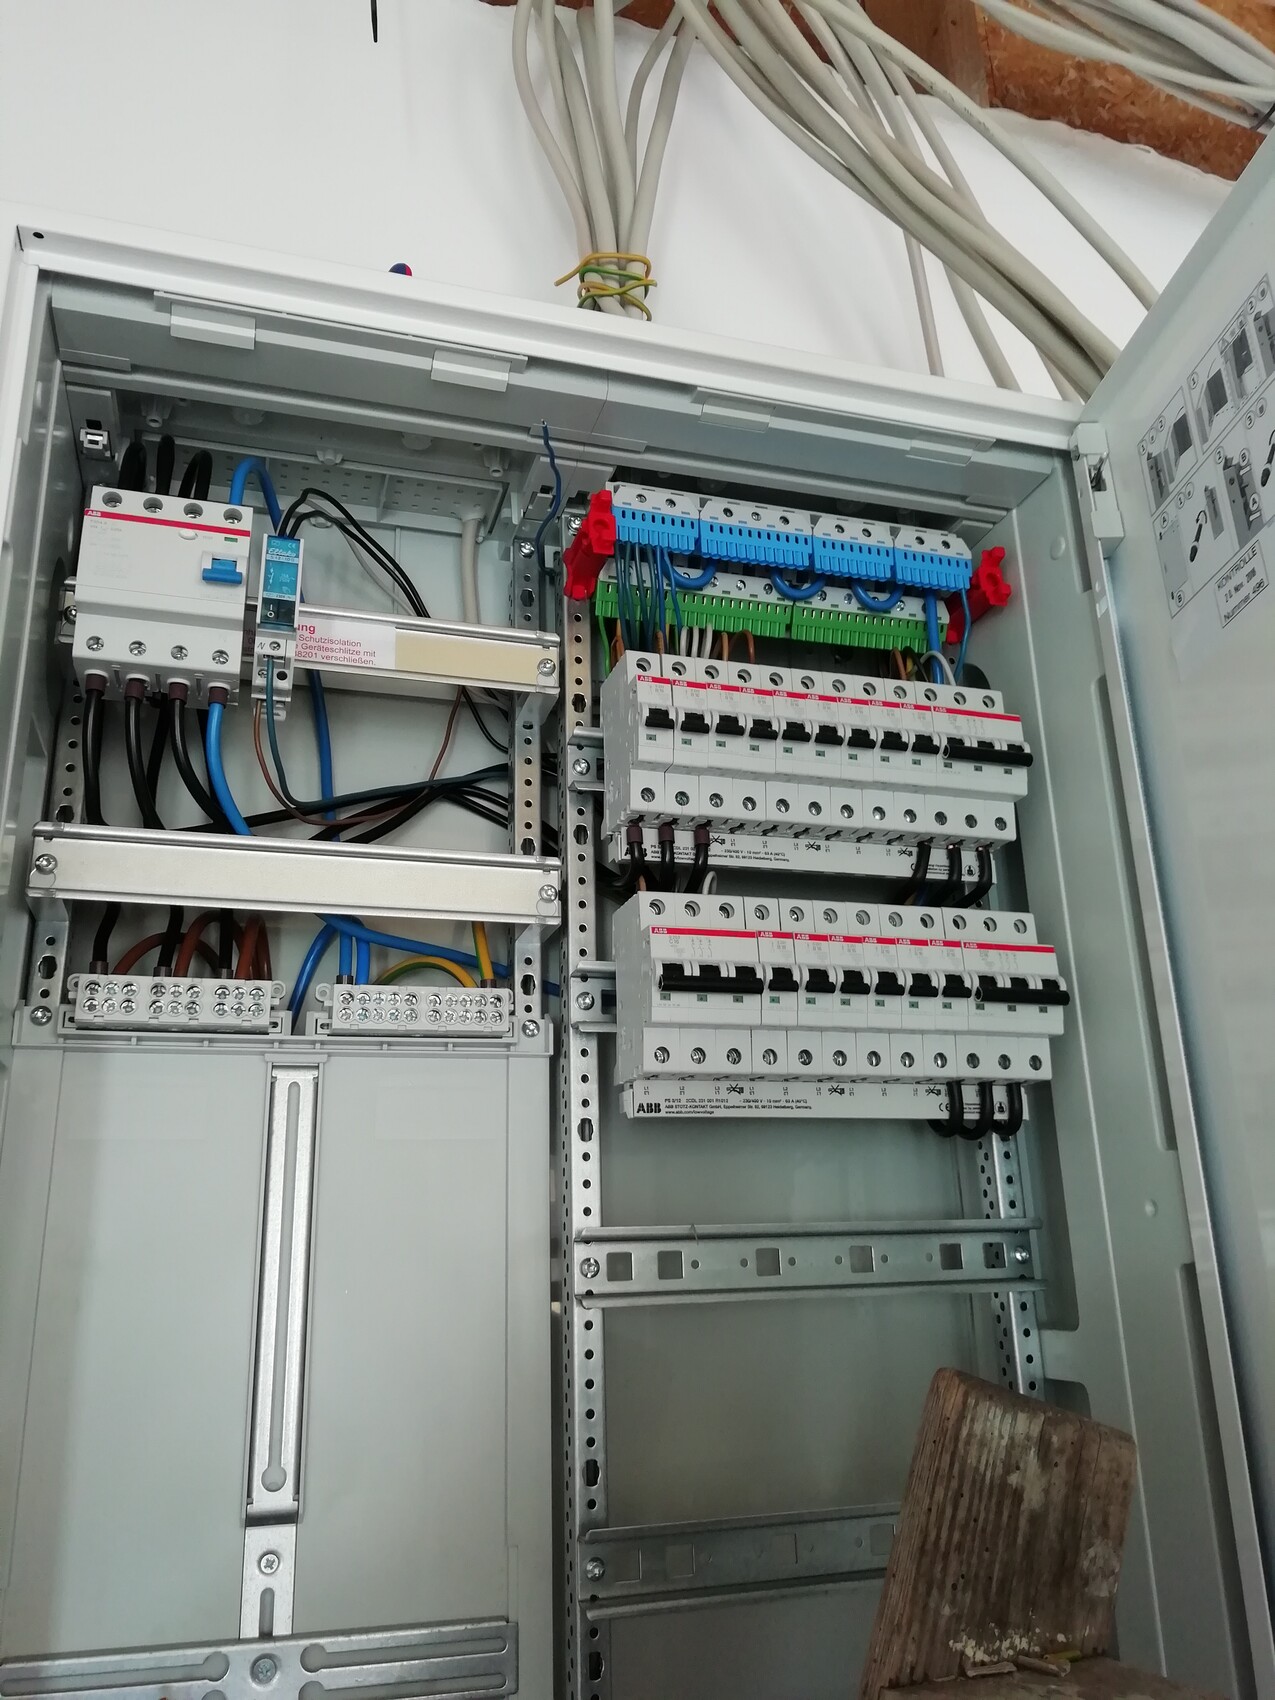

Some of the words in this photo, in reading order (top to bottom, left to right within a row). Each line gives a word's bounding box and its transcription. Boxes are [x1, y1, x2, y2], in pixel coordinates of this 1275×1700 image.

[298, 634, 362, 647] Schutzisolation
[301, 643, 361, 657] Geräteschlitze
[363, 650, 376, 658] mit
[320, 653, 376, 666] verschließen.
[965, 941, 978, 949] ABB
[636, 1102, 662, 1114] ABB
